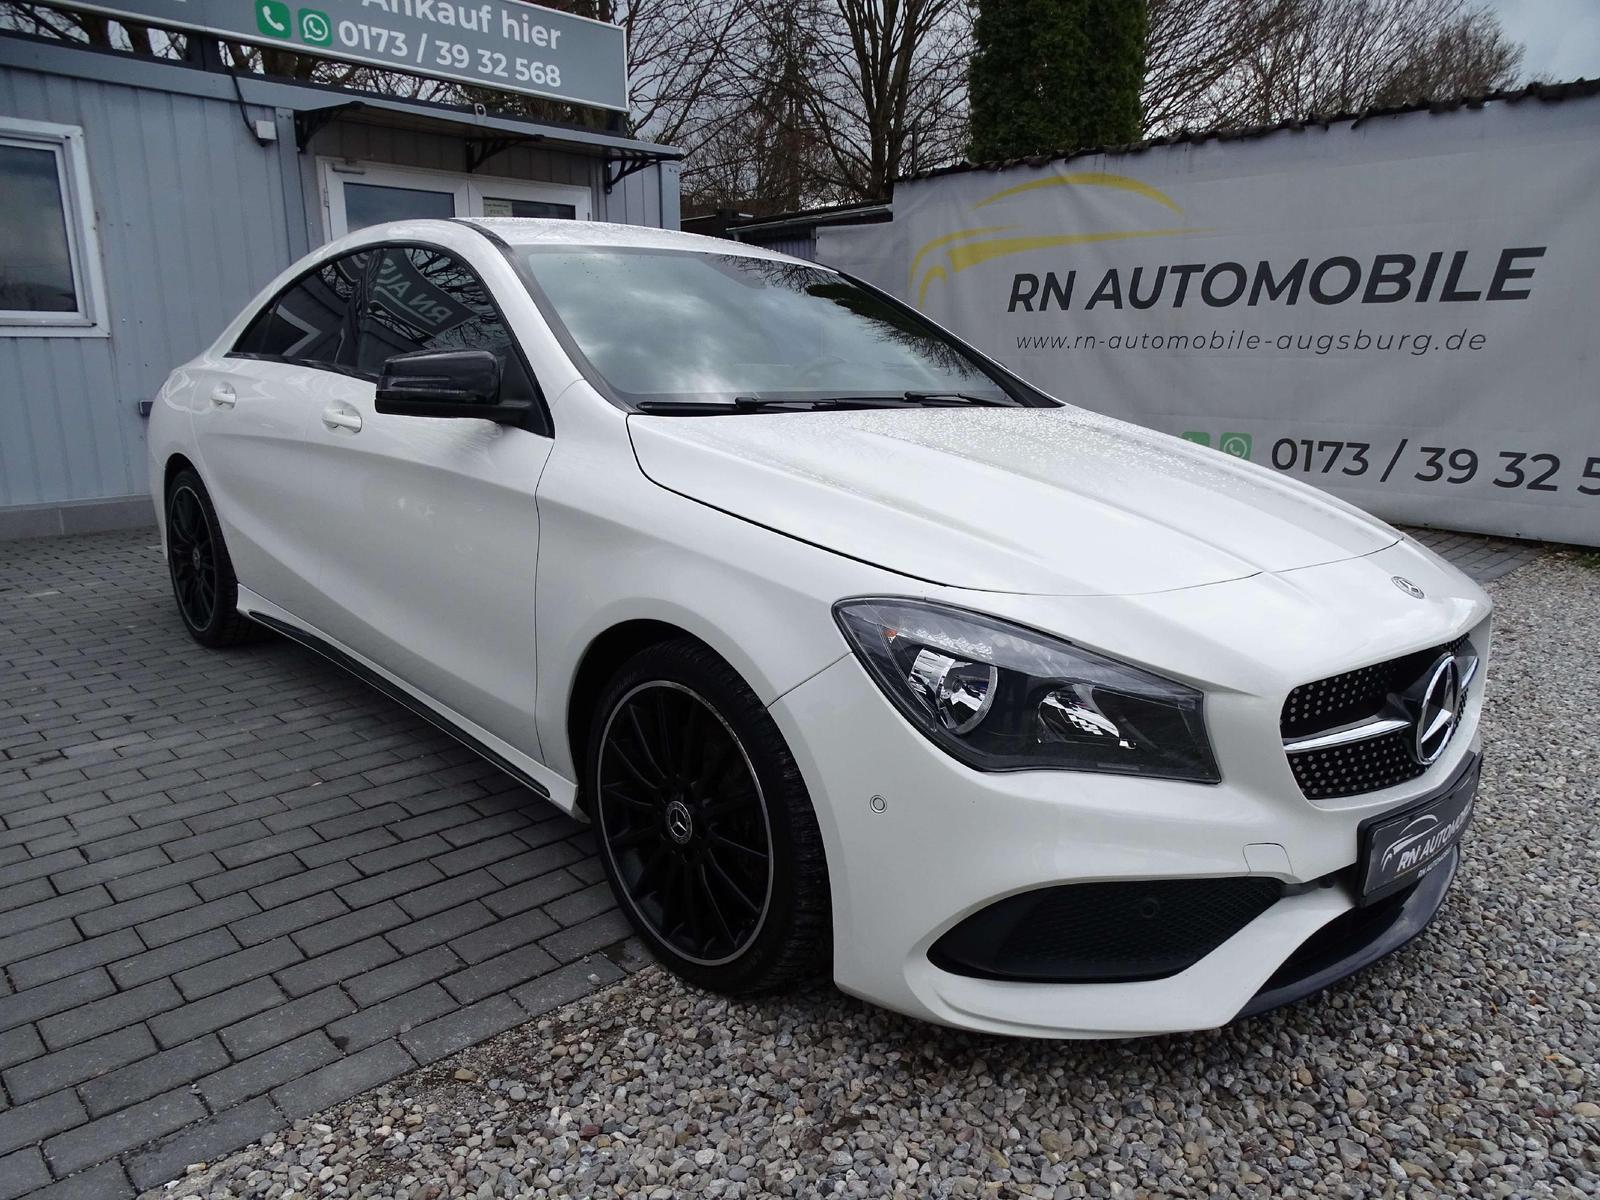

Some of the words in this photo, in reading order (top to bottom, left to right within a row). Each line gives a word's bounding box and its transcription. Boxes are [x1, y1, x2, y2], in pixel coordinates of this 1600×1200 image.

[338, 20, 408, 57] 0173
[416, 32, 428, 63] /
[435, 40, 470, 68] 39
[477, 48, 508, 78] 32
[515, 57, 561, 87] 568
[501, 8, 561, 49] hier
[1007, 270, 1077, 312] RN
[1084, 246, 1547, 310] AUTOMOBILE
[1016, 328, 1487, 356] www.rn-automobile-augsburg.de
[1271, 438, 1370, 476] 0173
[1380, 438, 1408, 482] /
[1414, 446, 1479, 484] 39
[1493, 451, 1561, 491] 32
